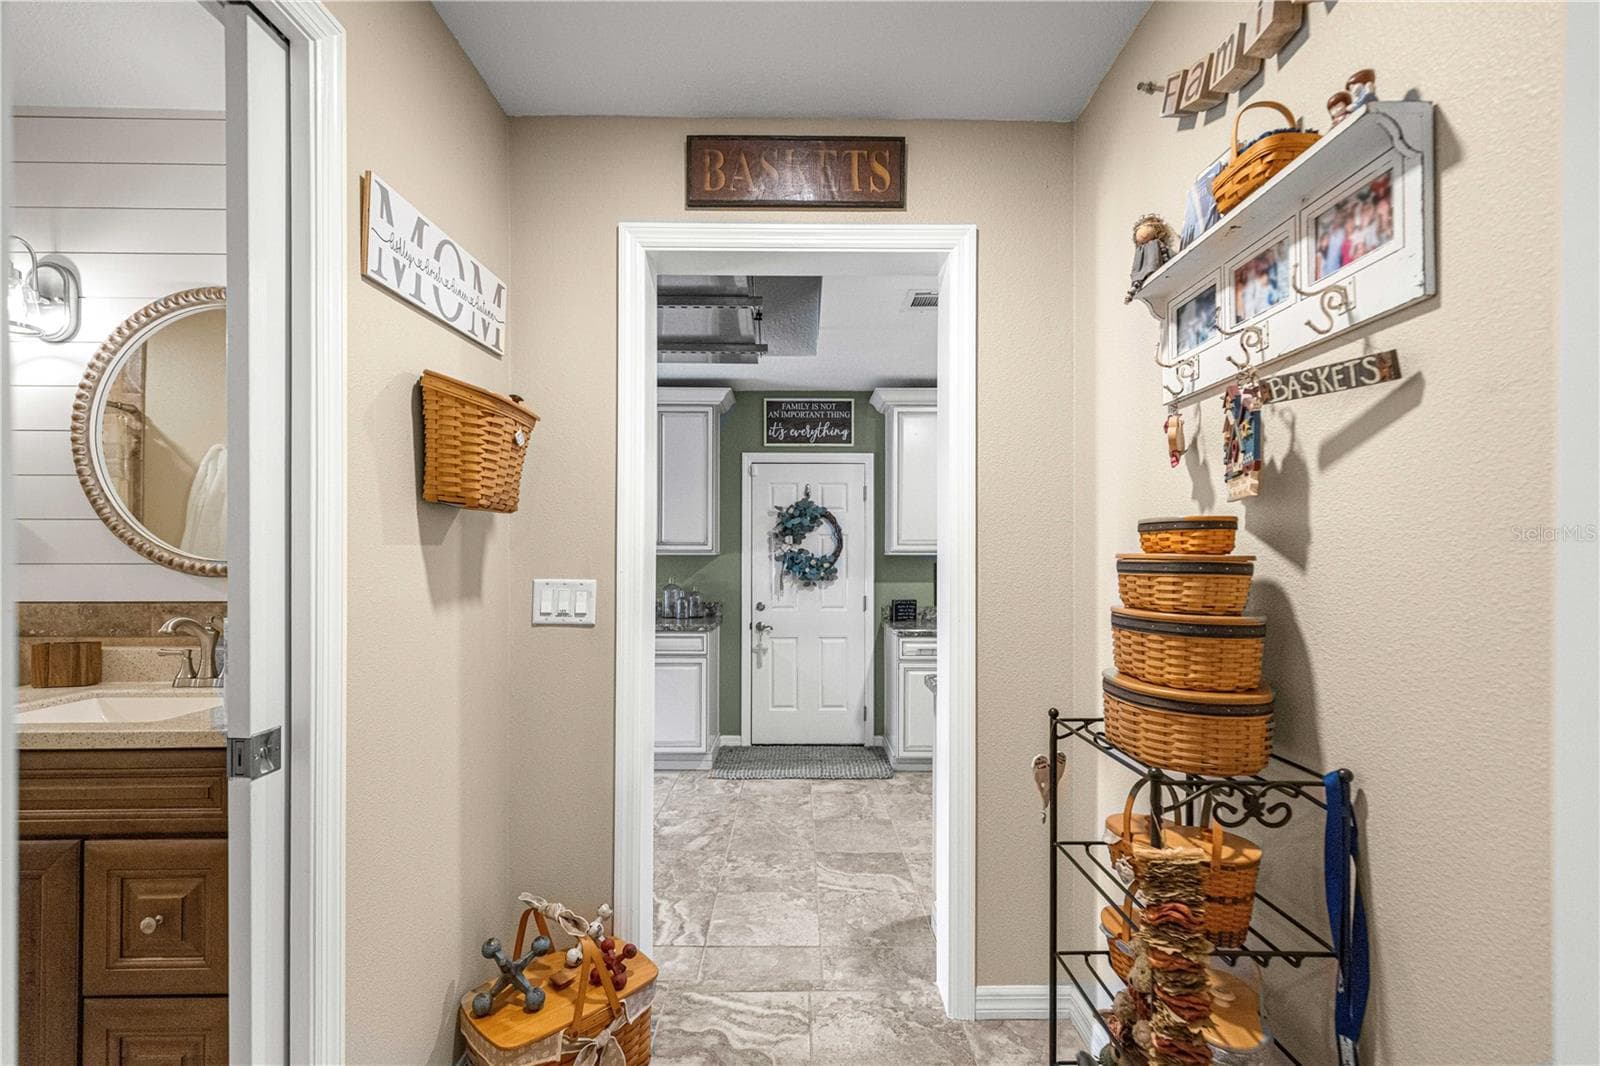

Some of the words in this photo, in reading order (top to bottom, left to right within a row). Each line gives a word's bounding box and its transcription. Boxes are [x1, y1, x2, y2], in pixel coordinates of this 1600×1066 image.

[703, 149, 891, 193] BASKETS
[371, 179, 505, 353] MOM
[1266, 356, 1381, 404] BASKETS
[768, 421, 786, 440] it's
[789, 421, 849, 443] everything
